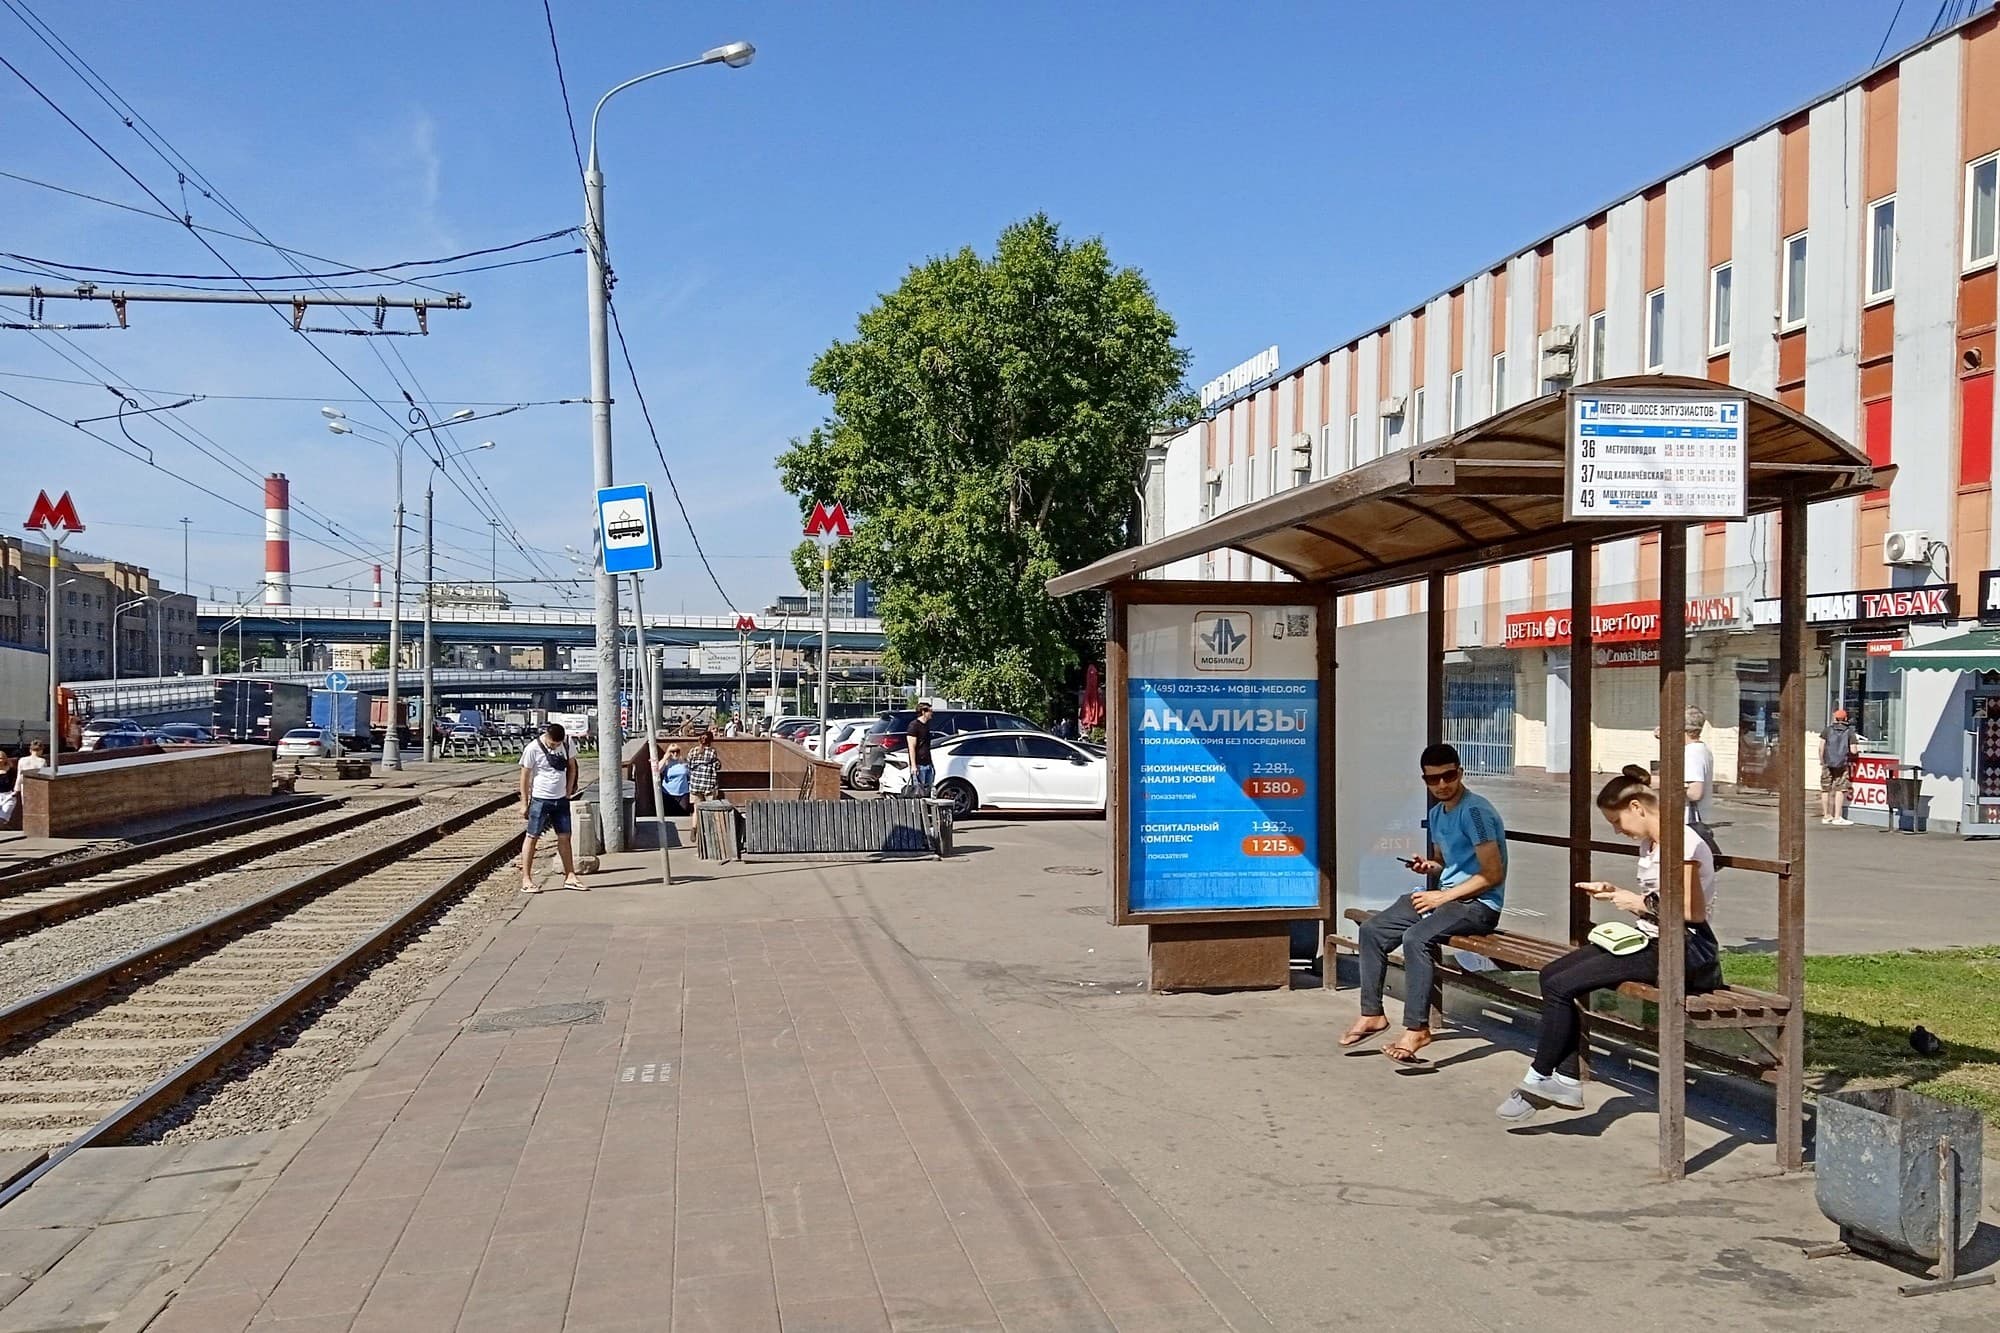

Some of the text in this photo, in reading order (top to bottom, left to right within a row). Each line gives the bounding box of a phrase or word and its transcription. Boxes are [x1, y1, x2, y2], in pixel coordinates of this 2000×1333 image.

[1600, 403, 1626, 415] МЕТРО
[1582, 440, 1596, 457] 36
[1605, 445, 1657, 455] МЕТРОГОРОДОК
[1581, 464, 1595, 483] 37
[1580, 489, 1595, 508] 43
[1863, 590, 1948, 618] ТАБАК
[1685, 597, 1739, 627] ДУКТЫ
[1505, 621, 1543, 643] ЦВЕТЫ
[1201, 656, 1245, 665] МОБИЛМЕД
[1607, 648, 1660, 664] СоюзЦвет
[1154, 685, 1176, 694] (495)
[1178, 685, 1220, 693] 021-32-14
[1228, 685, 1306, 694] MOBIL-MED.ORG
[1140, 737, 1306, 745] ТВОЯ ЛАБОРАТОРИЯ БЕЗ ПОСРЕДНИКОВ
[1141, 763, 1226, 773] БИОХИМИЧЕСКИЙ
[1140, 775, 1216, 784] АНАЛИЗ КРОВИ
[1847, 787, 1886, 806] ЗДЕС
[1141, 822, 1220, 833] ГОСПИТАЛЬНЫЙ
[1141, 835, 1193, 844] КОМПЛЕКС
